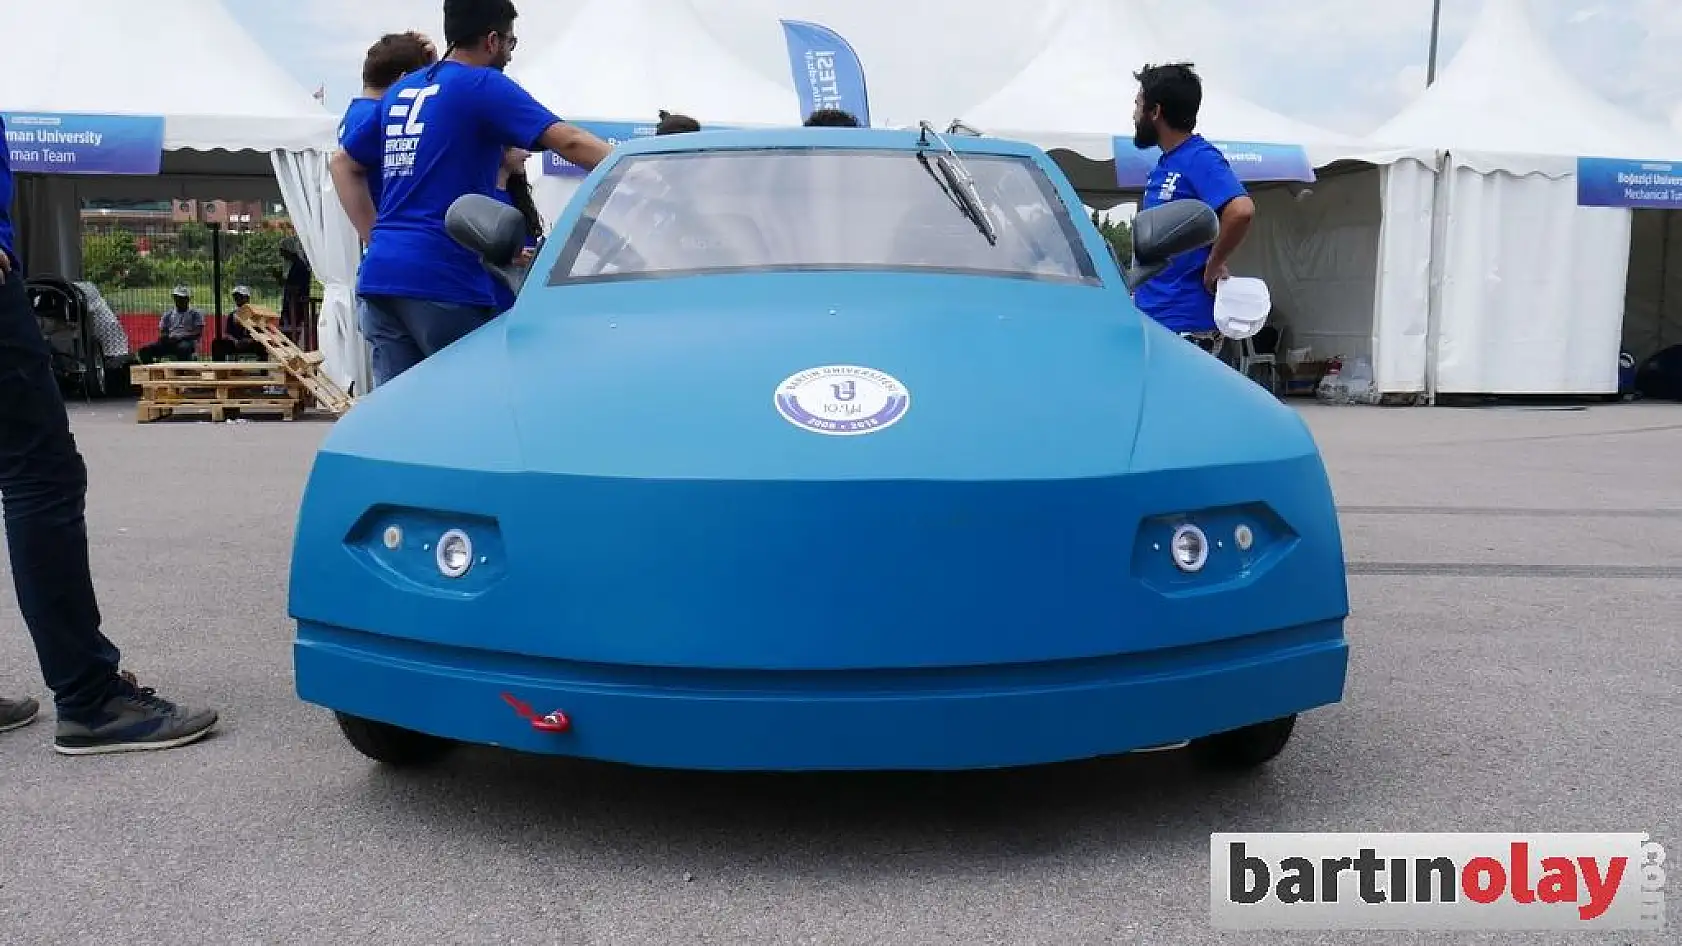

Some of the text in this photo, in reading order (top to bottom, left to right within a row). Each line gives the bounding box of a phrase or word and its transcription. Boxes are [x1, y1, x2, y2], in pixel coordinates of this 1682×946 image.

[386, 83, 441, 135] EC
[6, 129, 103, 146] man University
[10, 149, 77, 162] man Team
